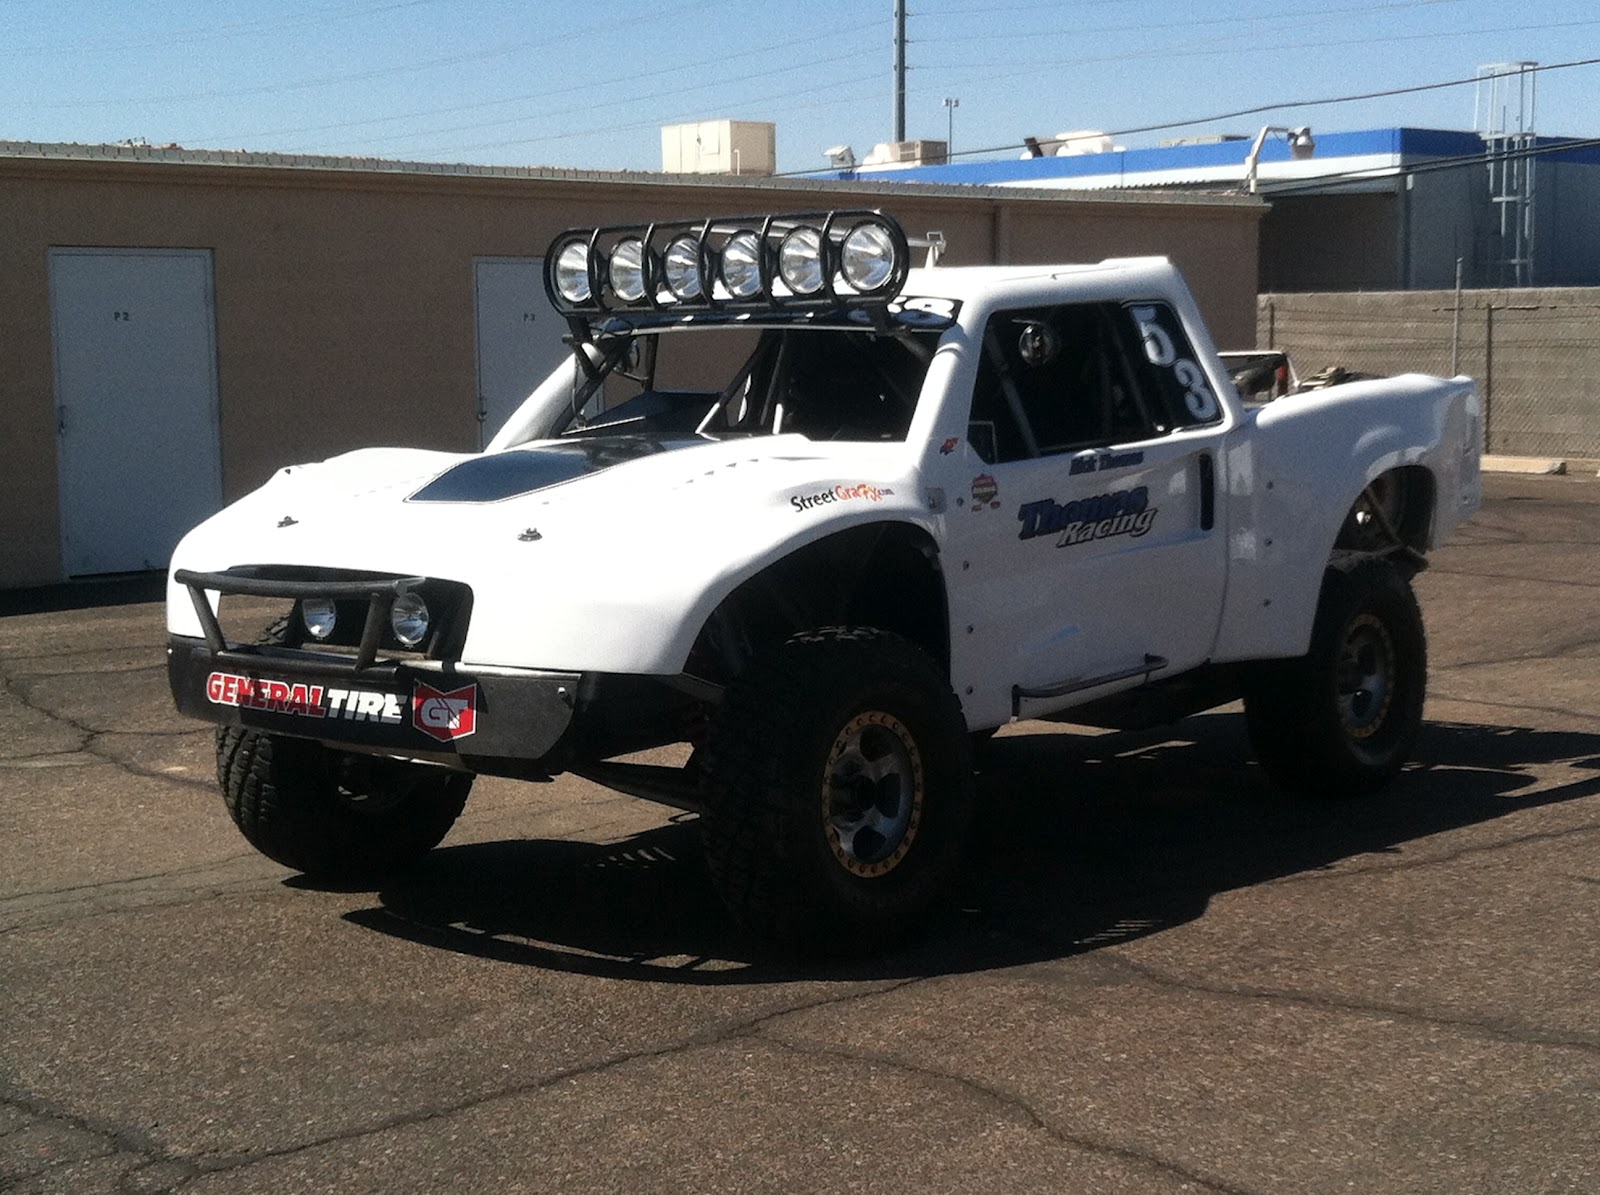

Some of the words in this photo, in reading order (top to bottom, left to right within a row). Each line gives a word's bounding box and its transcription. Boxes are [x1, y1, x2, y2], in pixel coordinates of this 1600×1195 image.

[1130, 306, 1216, 418] 53
[1056, 508, 1158, 548] Racing
[206, 672, 327, 717] GENERAL
[327, 689, 408, 724] TIRE
